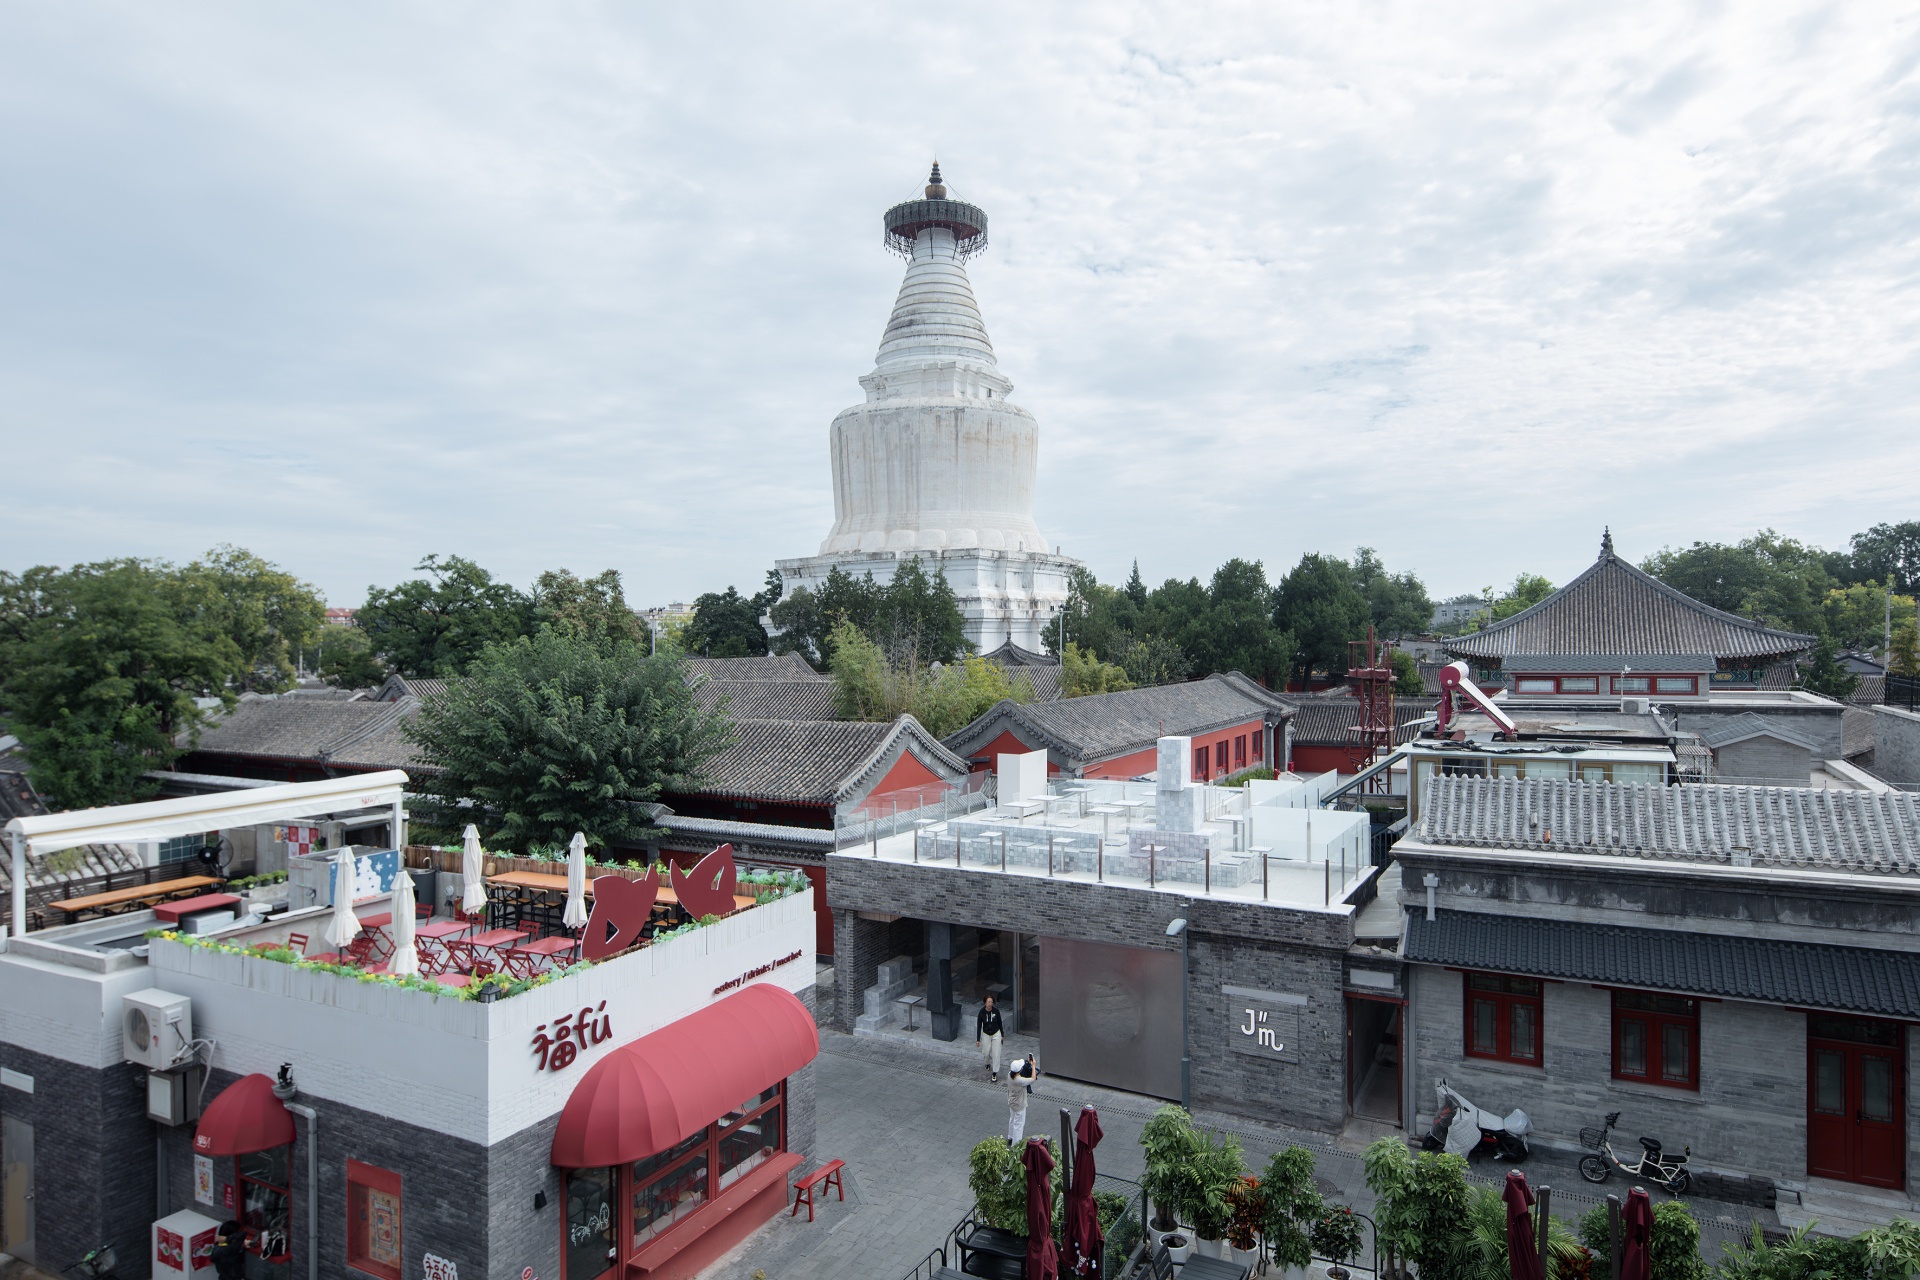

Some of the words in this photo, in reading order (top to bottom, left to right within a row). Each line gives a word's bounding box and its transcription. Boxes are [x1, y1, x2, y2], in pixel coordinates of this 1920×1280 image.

[714, 977, 741, 995] eatery
[747, 964, 771, 980] drinks
[776, 949, 803, 967] market
